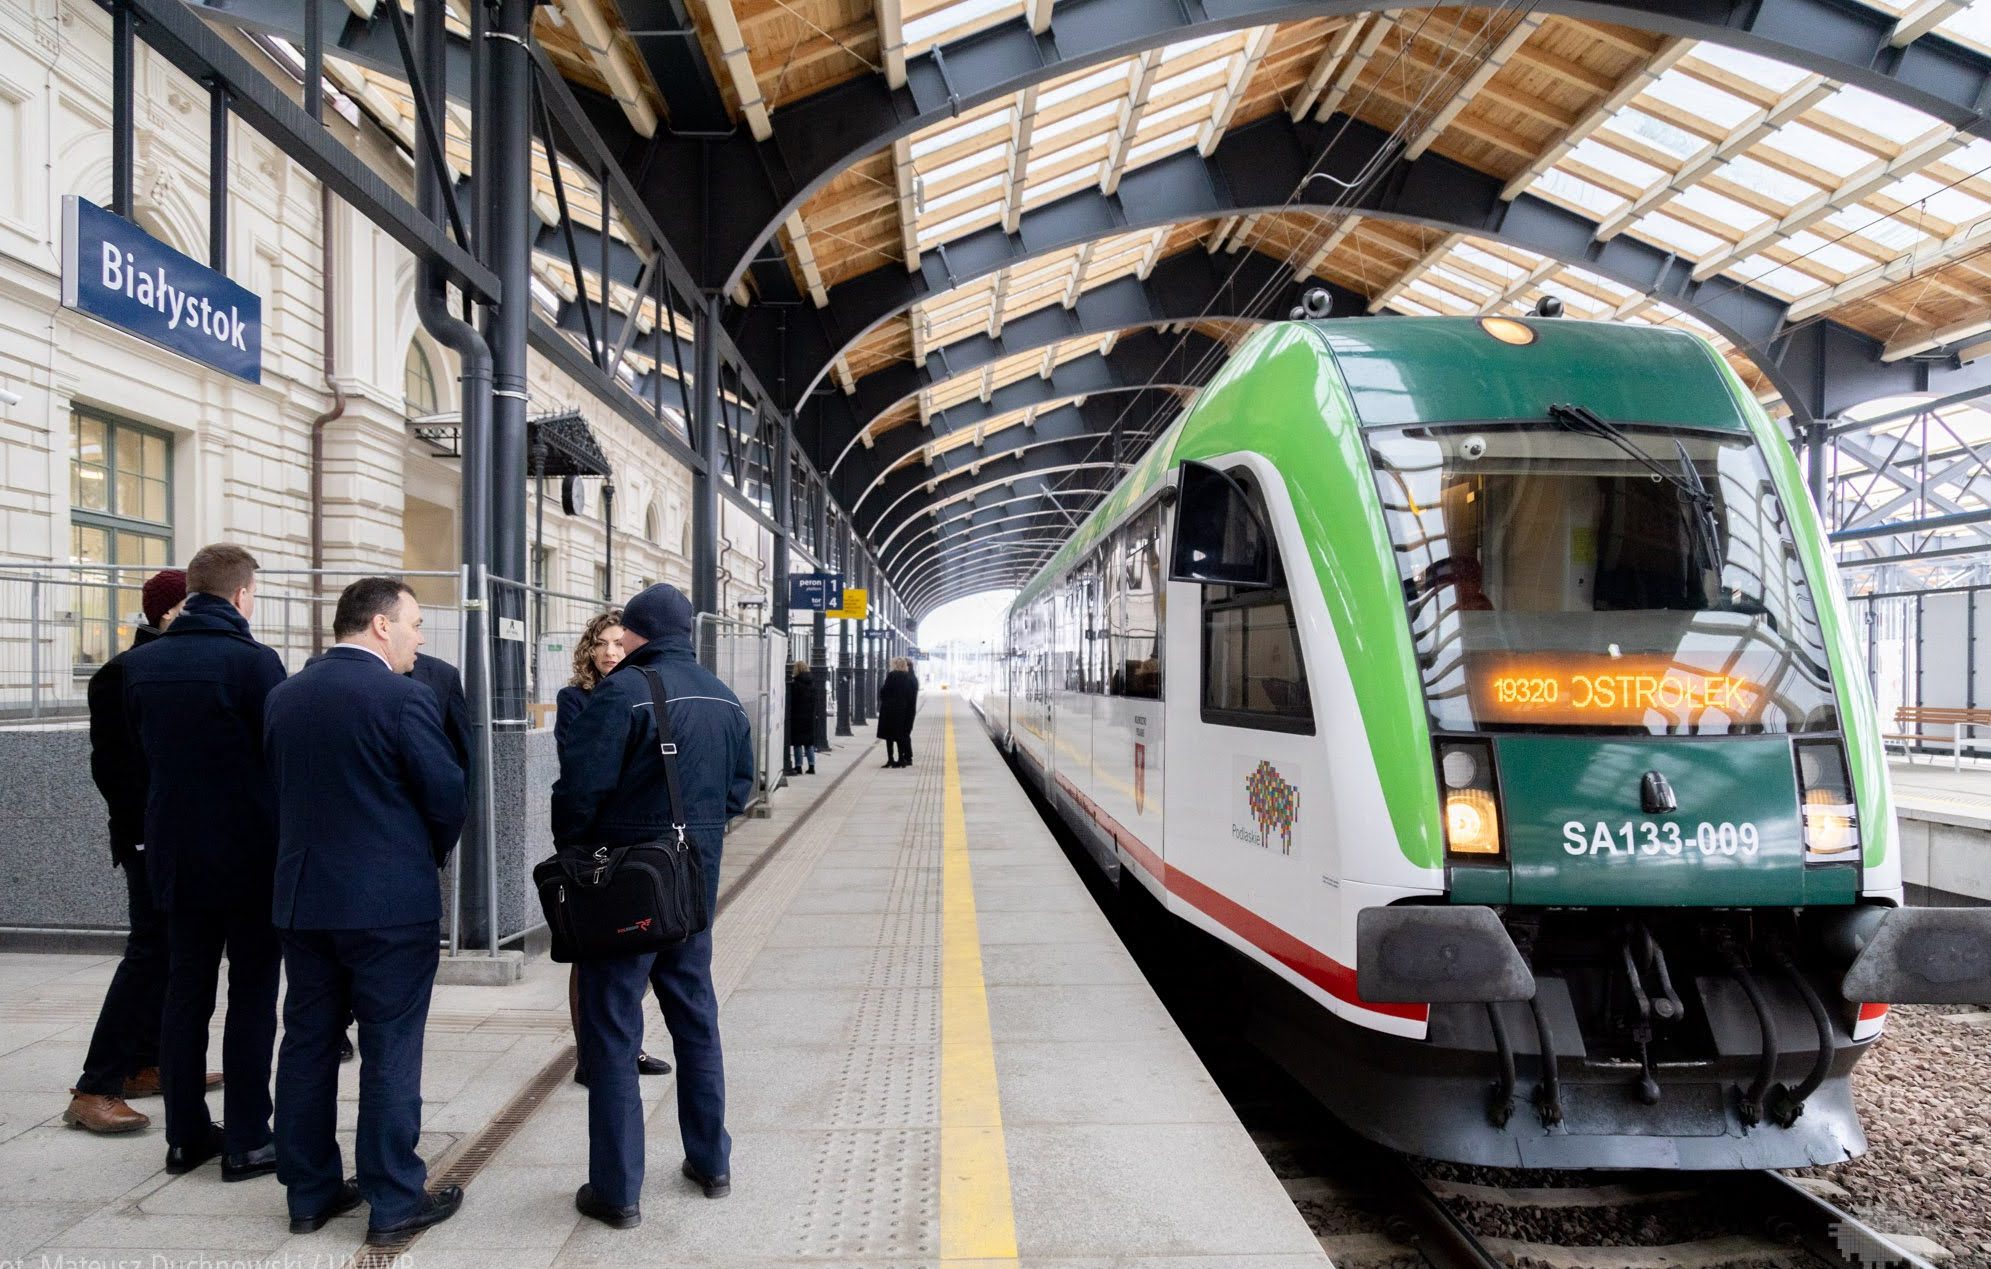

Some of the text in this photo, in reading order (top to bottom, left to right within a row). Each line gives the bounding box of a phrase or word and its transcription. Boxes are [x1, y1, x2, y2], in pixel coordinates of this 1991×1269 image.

[103, 240, 246, 352] Białystok
[799, 579, 837, 592] peron 1
[829, 597, 837, 608] 4
[1494, 678, 1559, 703] 19320
[1232, 823, 1261, 846] Podlaskie
[1562, 820, 1760, 856] SA133-009
